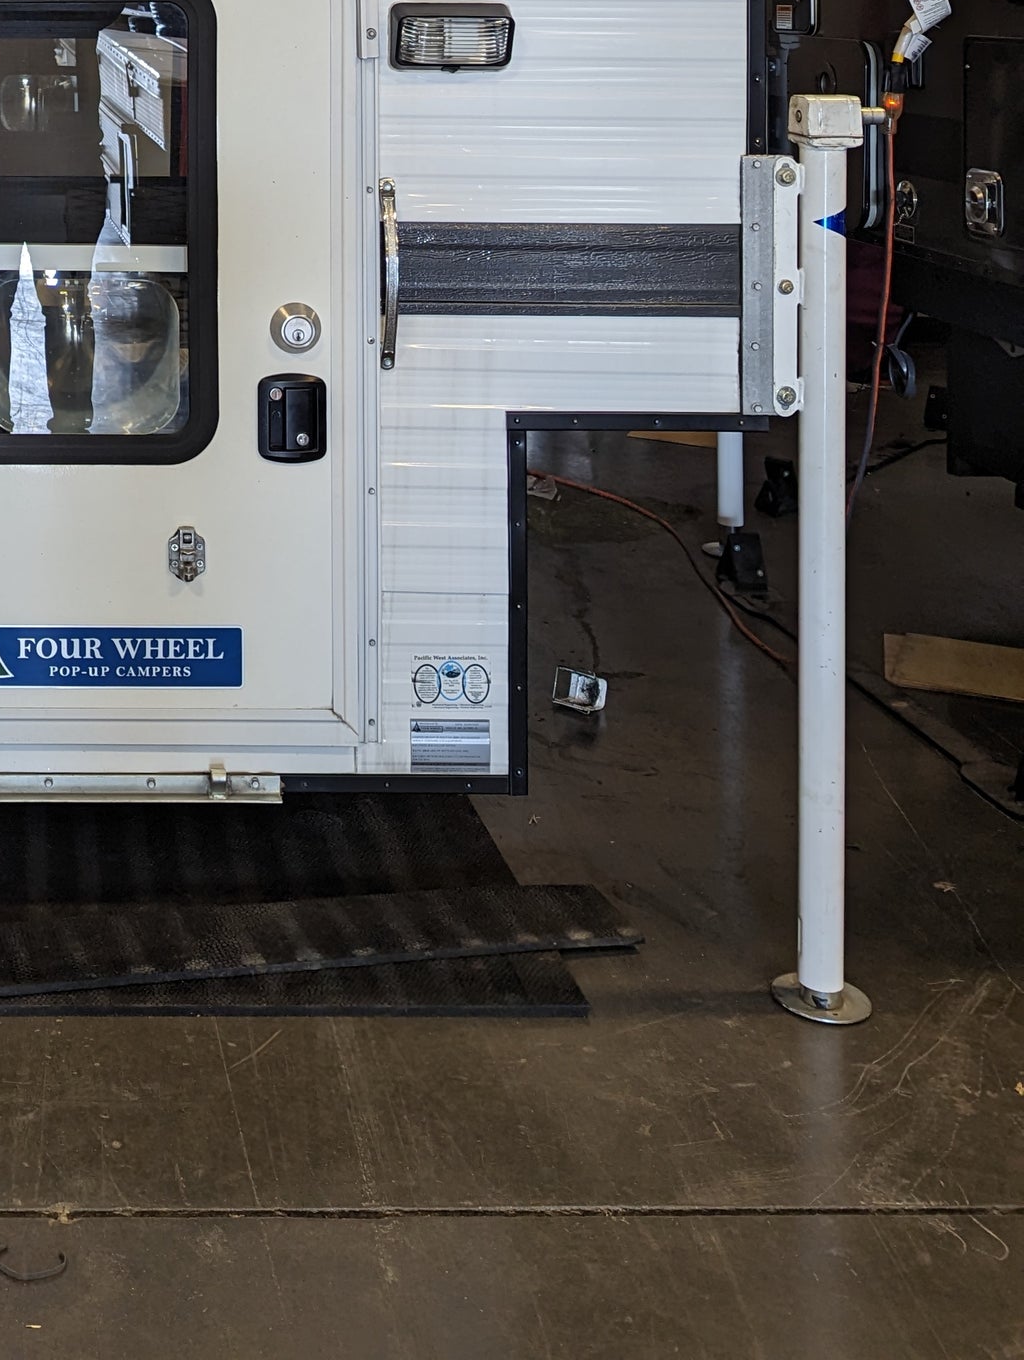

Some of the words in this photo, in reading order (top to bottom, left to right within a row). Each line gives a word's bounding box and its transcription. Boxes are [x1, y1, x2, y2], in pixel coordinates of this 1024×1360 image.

[17, 637, 103, 659] FOUR
[111, 637, 224, 659] WHEEL
[49, 665, 110, 677] POP-UP
[116, 665, 191, 677] CAMPERS
